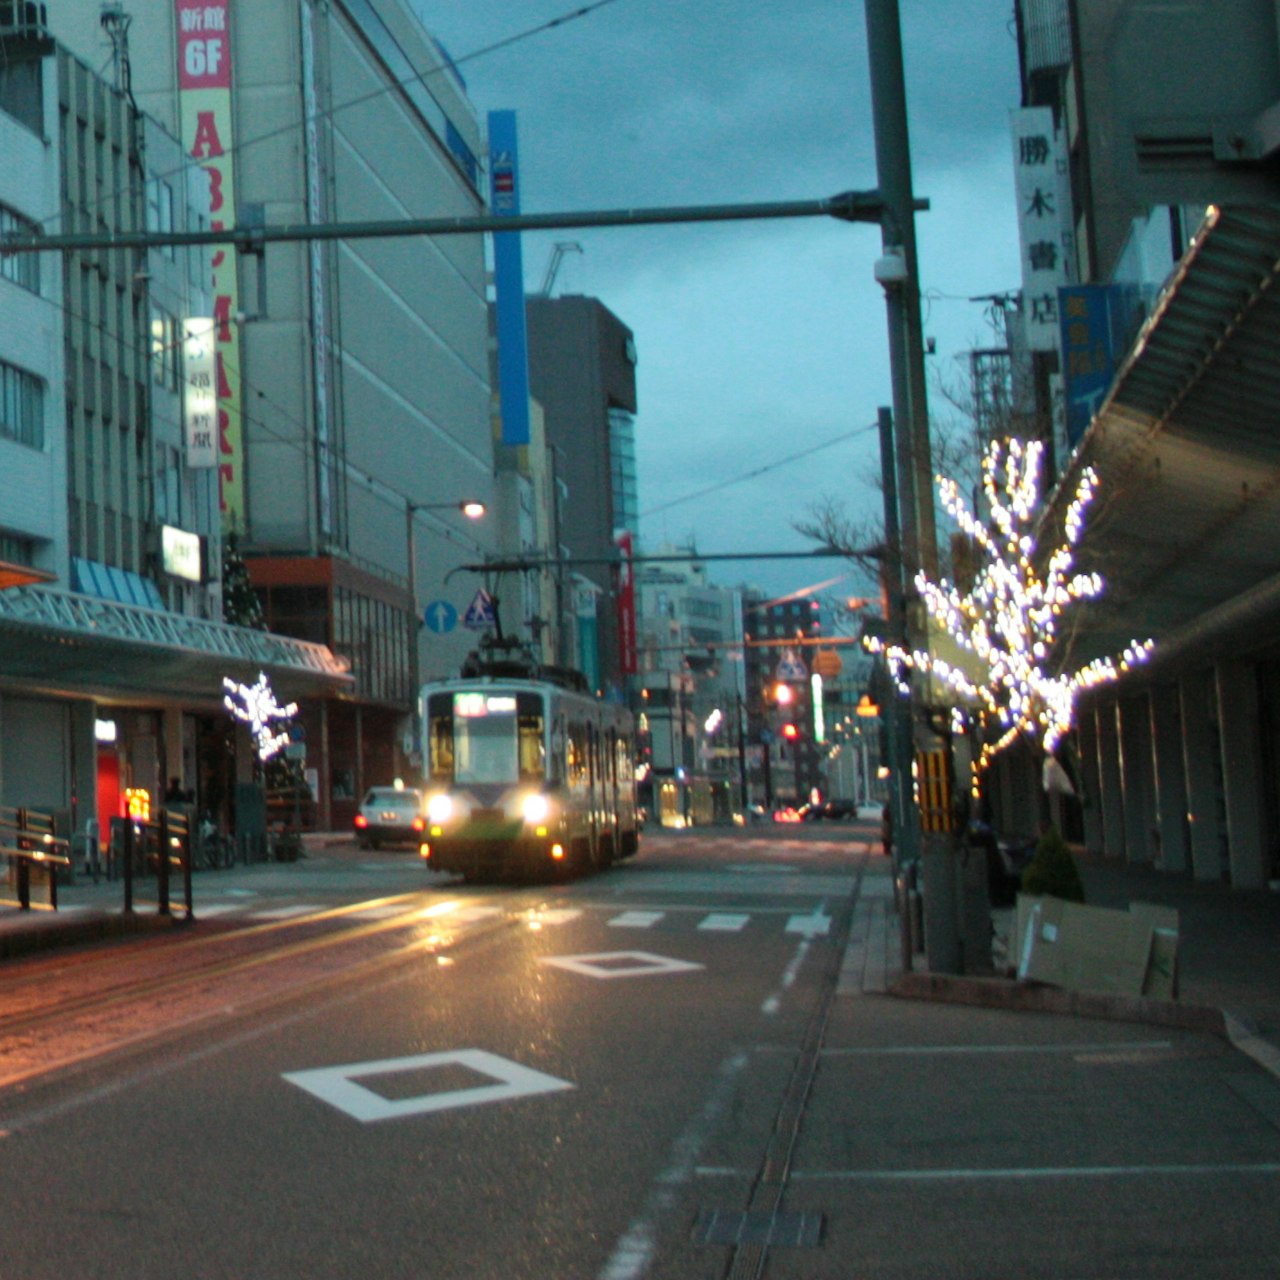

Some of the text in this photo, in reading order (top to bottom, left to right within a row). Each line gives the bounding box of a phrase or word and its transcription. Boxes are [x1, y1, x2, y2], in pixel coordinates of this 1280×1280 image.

[184, 38, 223, 77] 6F
[1019, 135, 1057, 326] 勝木書店
